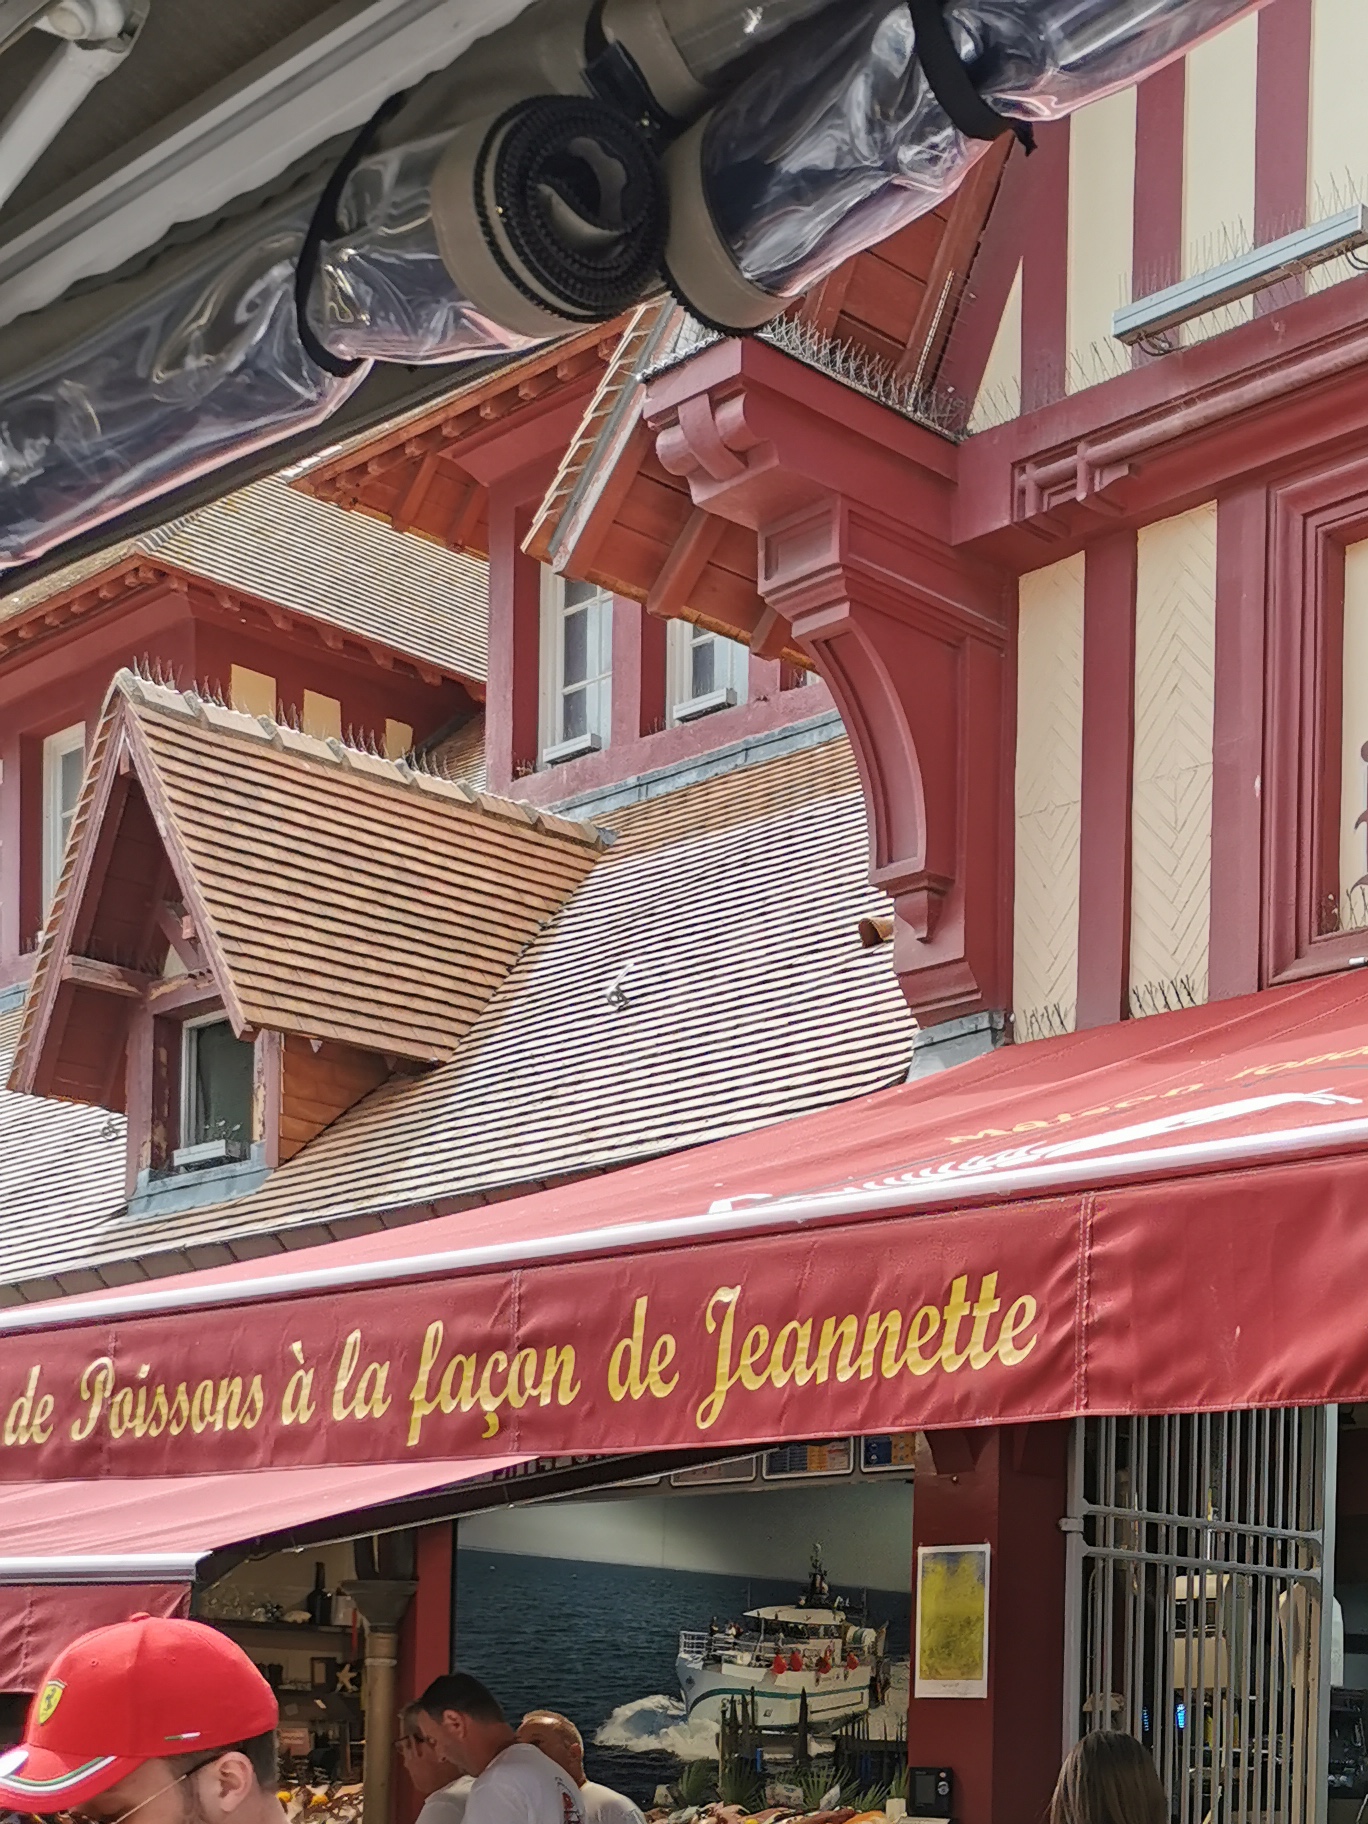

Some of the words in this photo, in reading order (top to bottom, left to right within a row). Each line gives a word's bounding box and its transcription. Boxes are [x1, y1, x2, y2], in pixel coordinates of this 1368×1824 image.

[3, 1365, 54, 1446] de
[71, 1357, 264, 1441] Poissons
[281, 1340, 315, 1426] à
[331, 1328, 391, 1422] la
[407, 1320, 581, 1446] façon
[607, 1295, 680, 1402] de
[695, 1271, 1038, 1430] Jeannette
